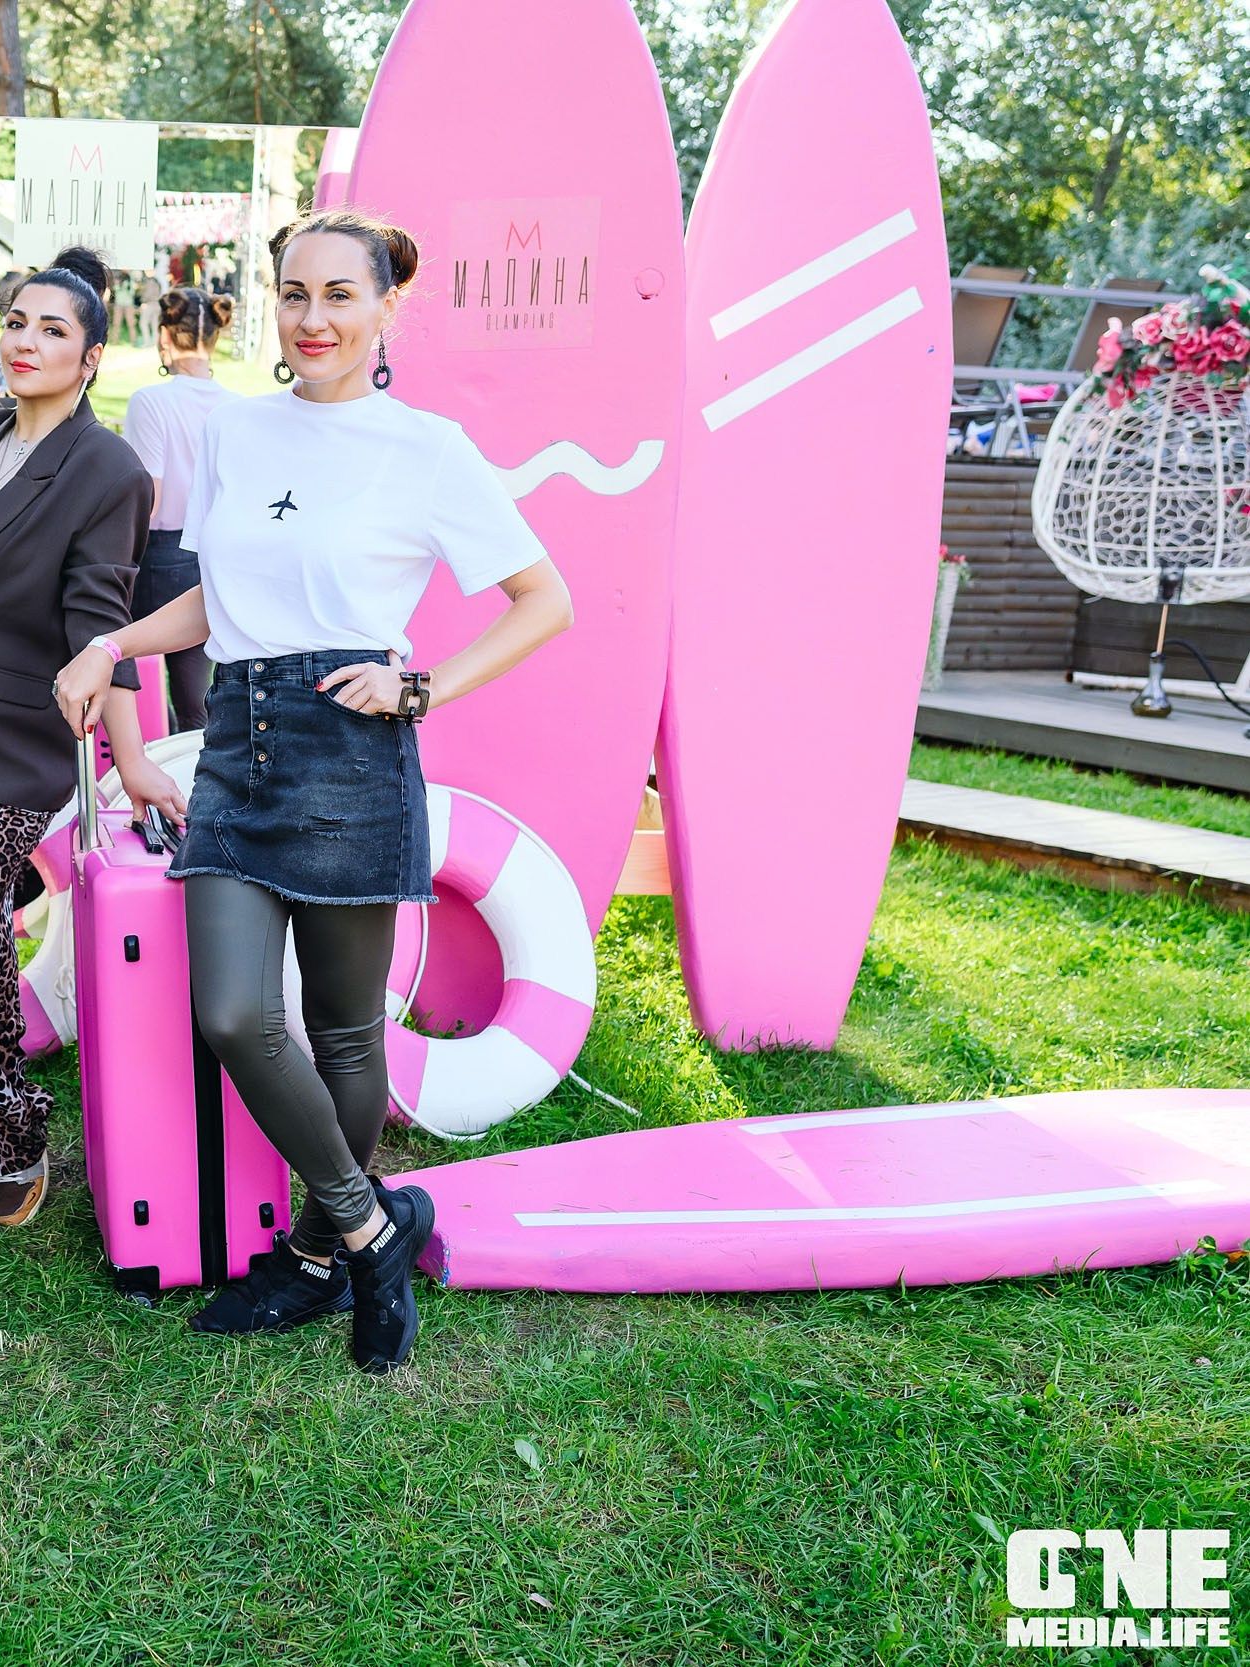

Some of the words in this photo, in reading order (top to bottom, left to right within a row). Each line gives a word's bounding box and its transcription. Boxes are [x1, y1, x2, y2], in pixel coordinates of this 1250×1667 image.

[20, 177, 149, 228] МАЛИНА
[453, 256, 588, 309] МАЛИНА
[485, 311, 555, 332] GLAMPING
[370, 1221, 398, 1254] PUMA
[299, 1260, 332, 1281] PUMA
